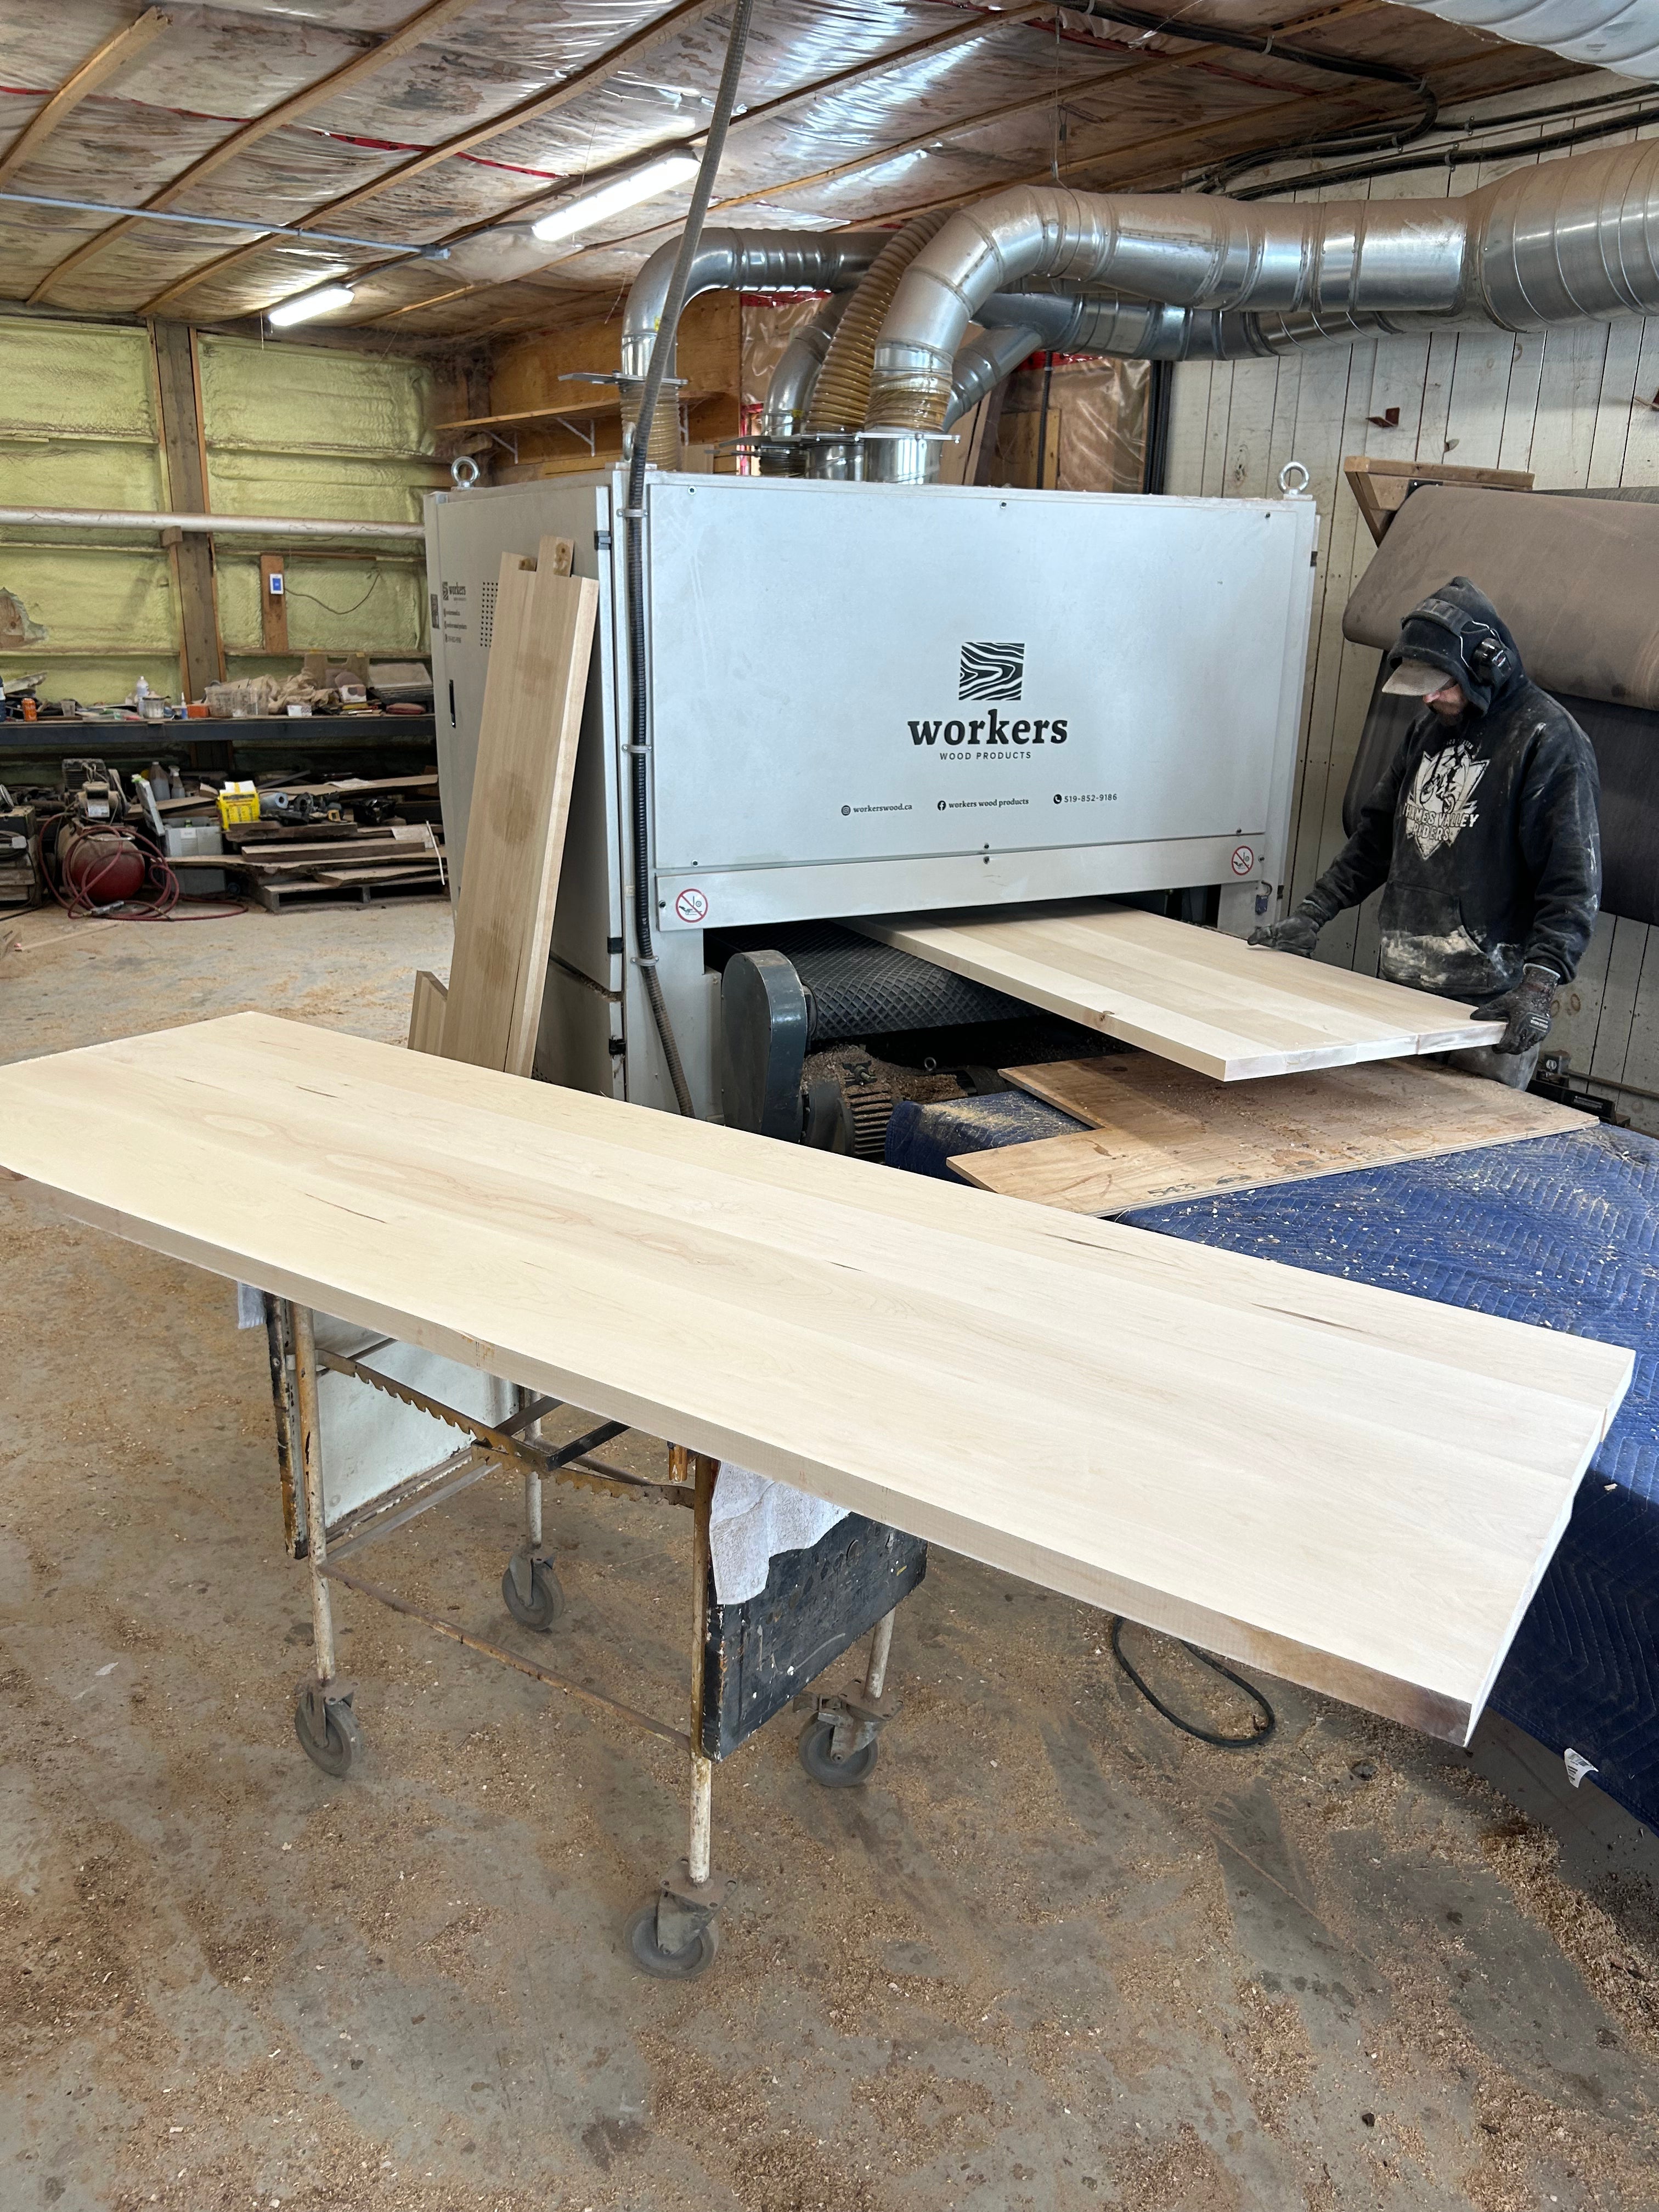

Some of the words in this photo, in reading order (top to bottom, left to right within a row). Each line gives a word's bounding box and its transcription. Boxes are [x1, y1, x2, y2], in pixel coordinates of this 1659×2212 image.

[907, 708, 1068, 745] workers
[976, 752, 1031, 760] PRODUCTS
[949, 800, 977, 808] workers
[979, 799, 997, 807] wood
[998, 798, 1029, 808] products
[1064, 793, 1118, 803] 519-852-9186
[853, 803, 913, 813] workerswood.ca
[1438, 812, 1480, 827] VALLEY
[1412, 822, 1449, 841] RIDERS
